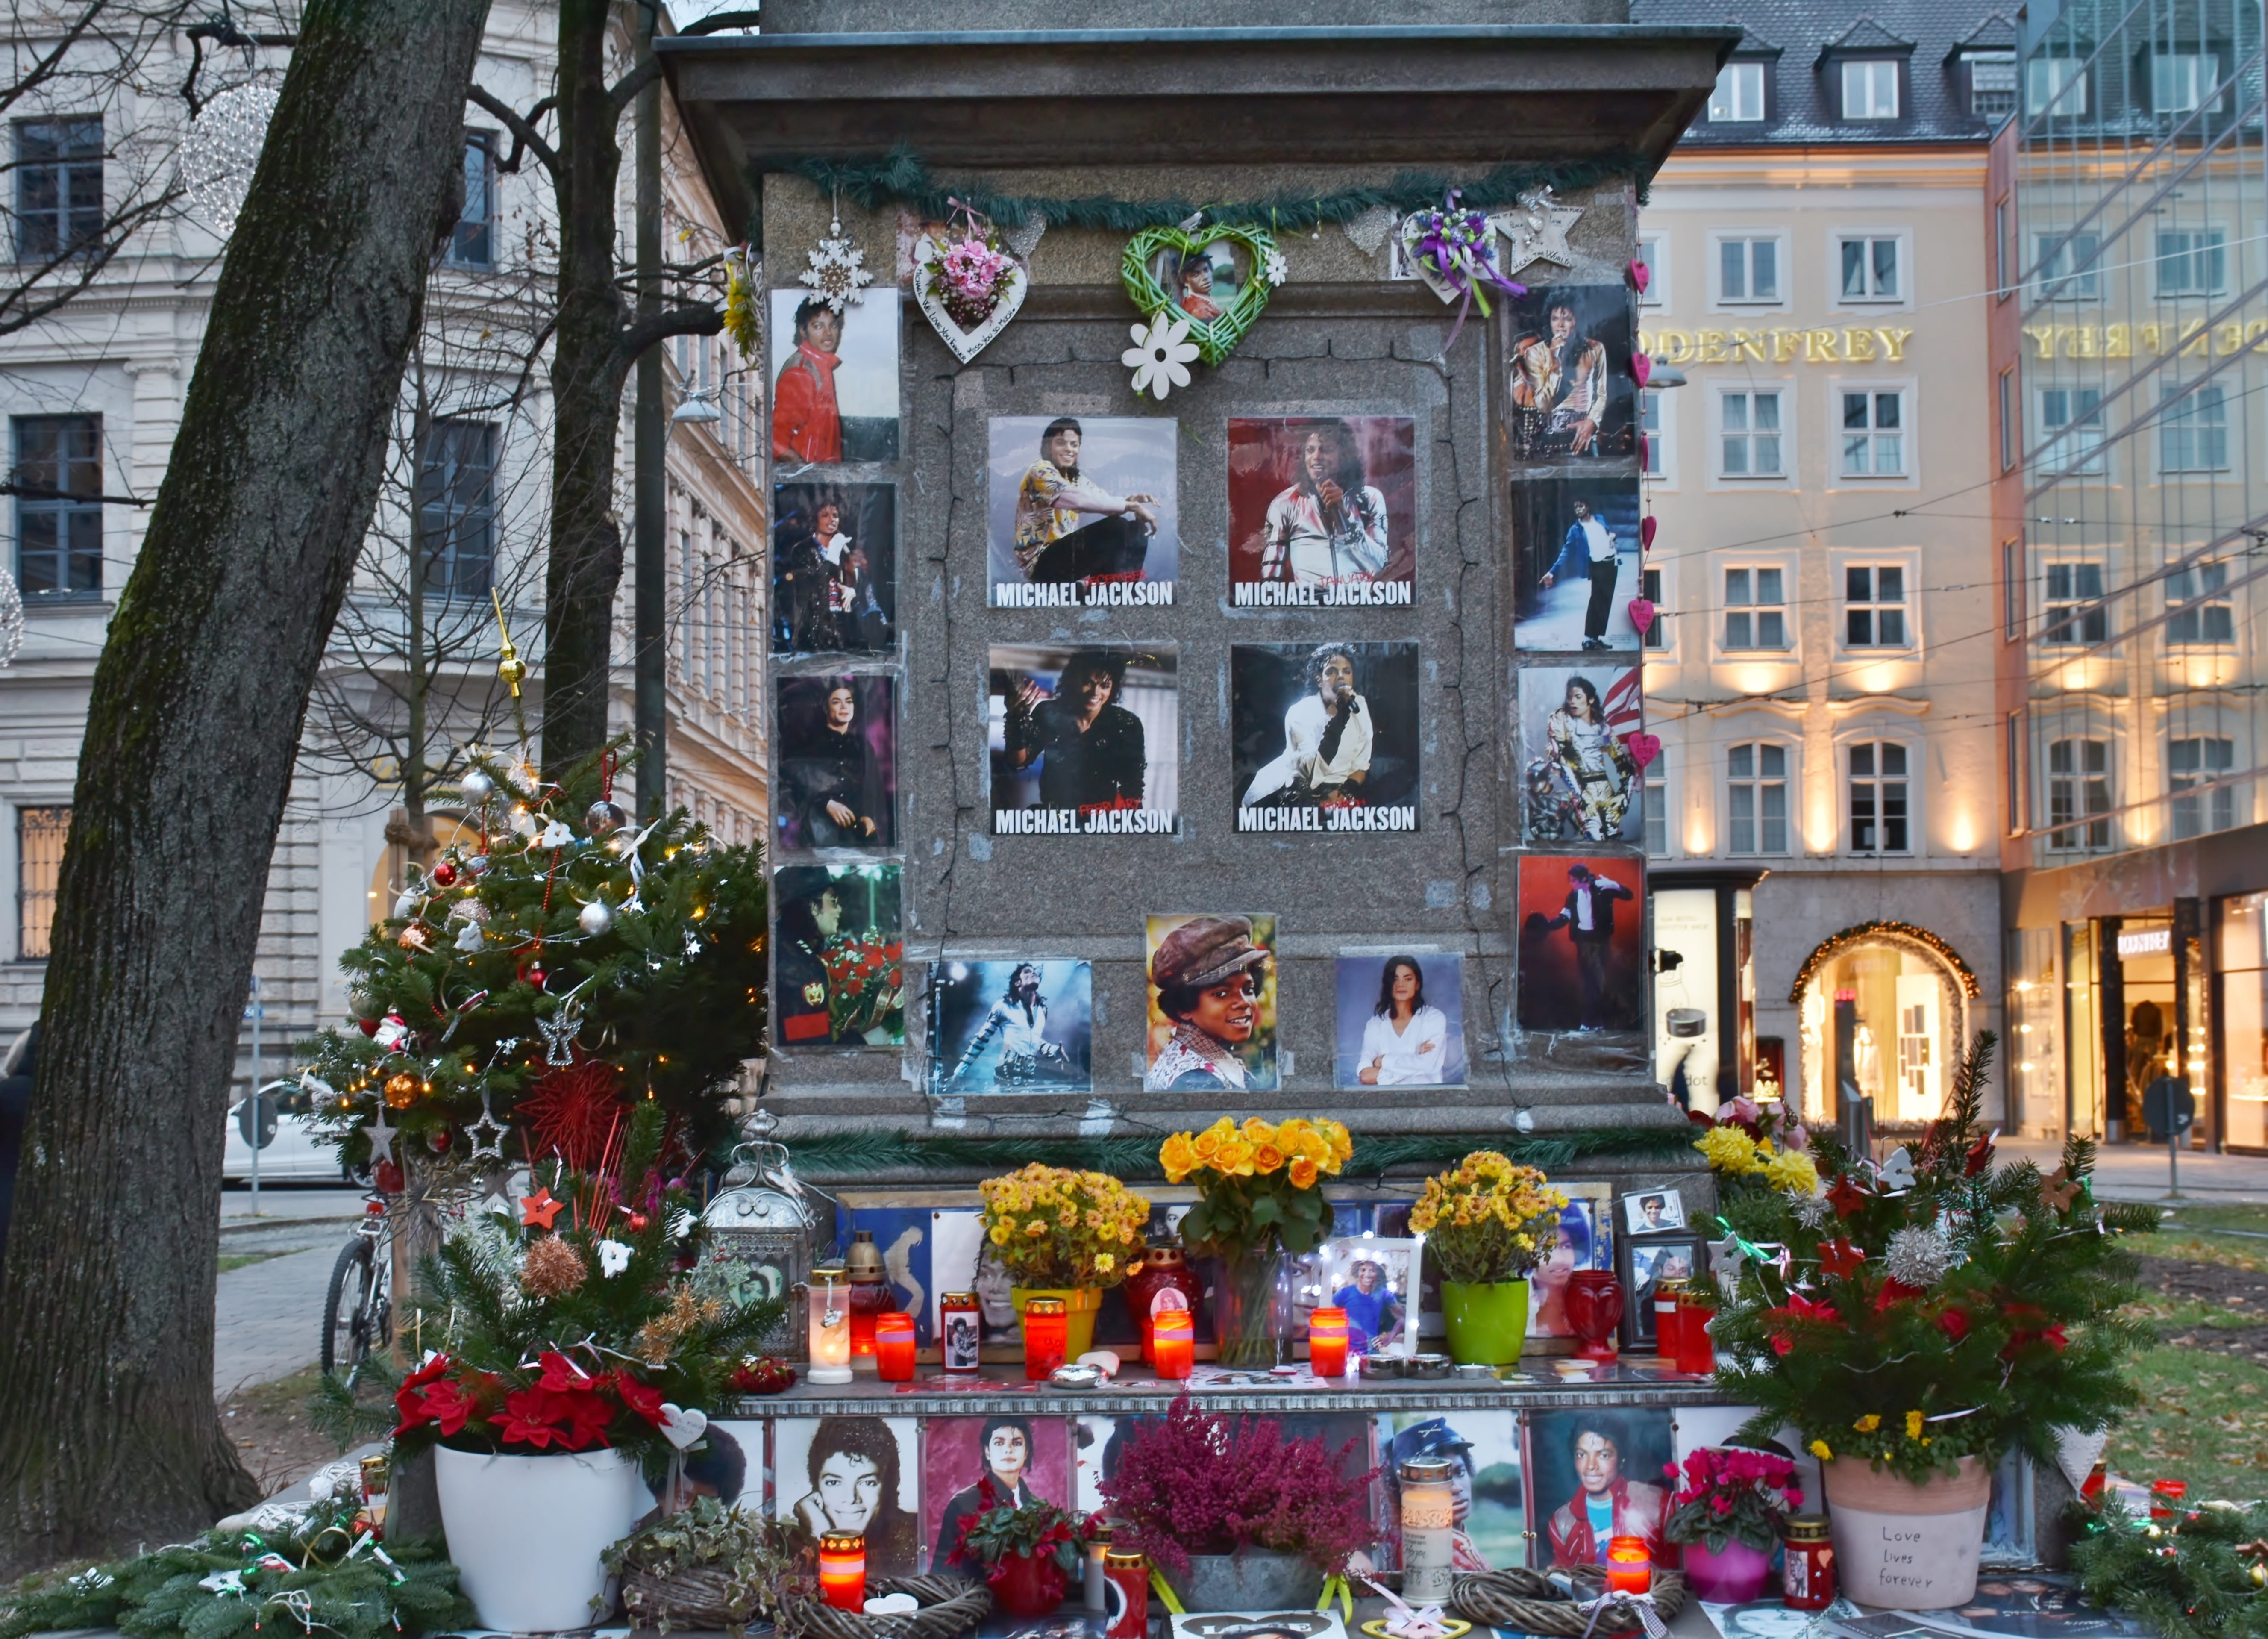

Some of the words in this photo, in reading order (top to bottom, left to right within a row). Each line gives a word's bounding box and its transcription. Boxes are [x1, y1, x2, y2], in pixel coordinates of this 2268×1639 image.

[1514, 257, 1532, 269] HEAL
[929, 312, 942, 330] LOVE
[938, 327, 951, 341] YOU
[967, 342, 983, 355] MISS
[982, 333, 993, 347] YOU
[993, 326, 1000, 334] SO
[997, 582, 1081, 606] MICHAEL
[1084, 581, 1172, 606] JACKSON
[1235, 582, 1319, 606] MICHAEL
[1323, 581, 1411, 605] JACKSON
[996, 809, 1080, 833] MICHAEL
[1084, 809, 1172, 833] JACKSON
[1239, 806, 1323, 831] MICHAEL
[1327, 806, 1415, 830] JACKSON
[1883, 1526, 1920, 1542] Love
[1884, 1549, 1913, 1564] lives
[1879, 1568, 1932, 1588] forever
